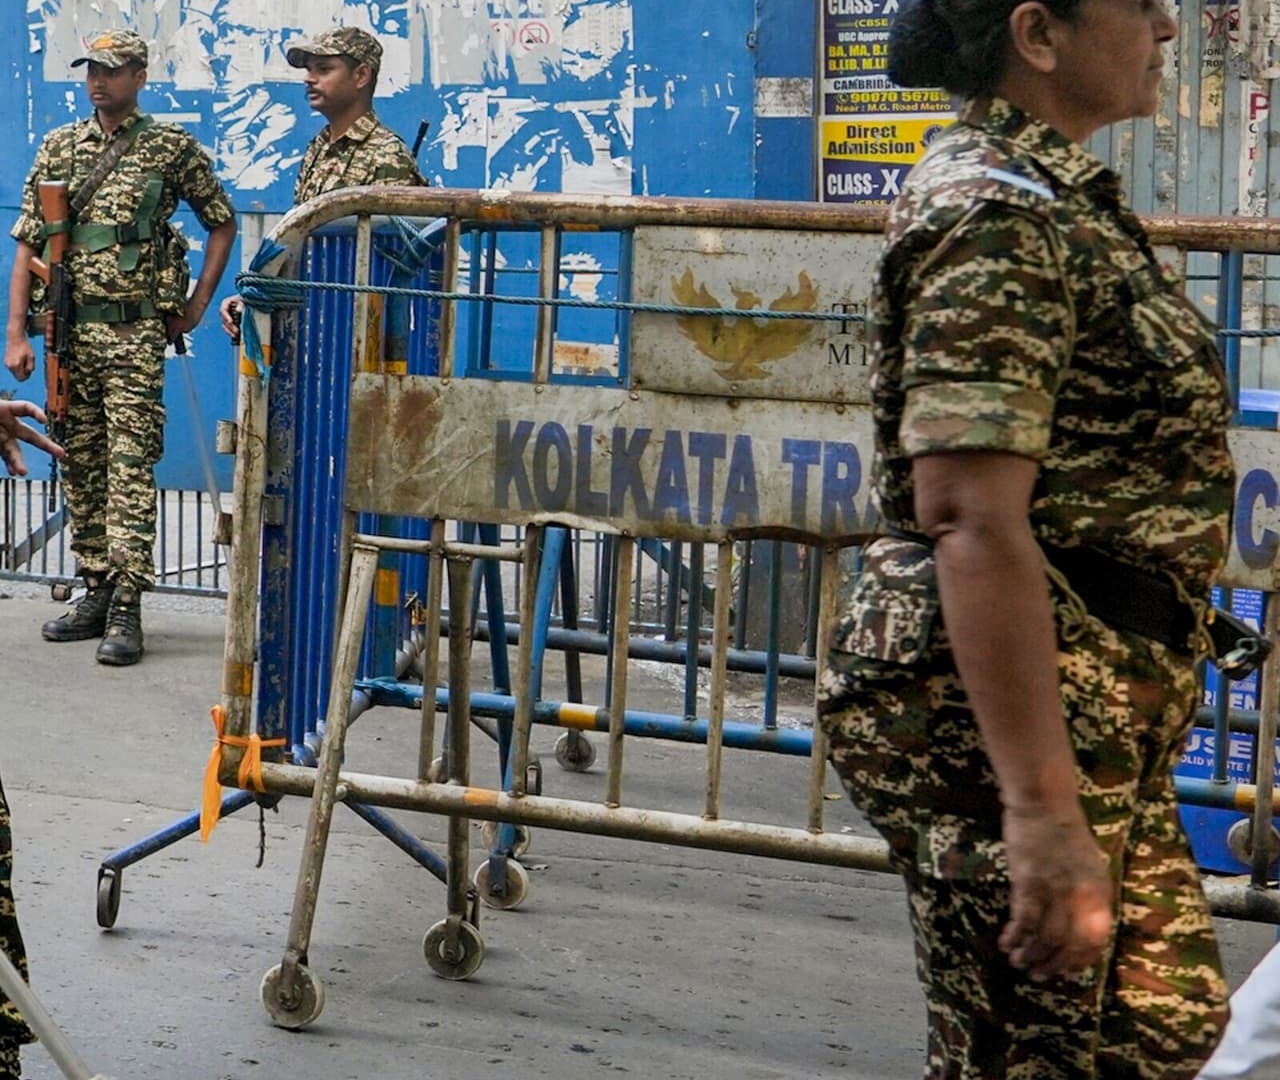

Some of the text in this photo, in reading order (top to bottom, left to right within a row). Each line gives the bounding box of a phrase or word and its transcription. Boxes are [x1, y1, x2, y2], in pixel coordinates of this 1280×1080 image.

[839, 32, 856, 41] UGC
[847, 125, 896, 139] Direct
[828, 142, 915, 155] Admission
[827, 173, 879, 195] CLASS-
[494, 419, 760, 526] KOLKATA
[1181, 755, 1204, 765] OLID
